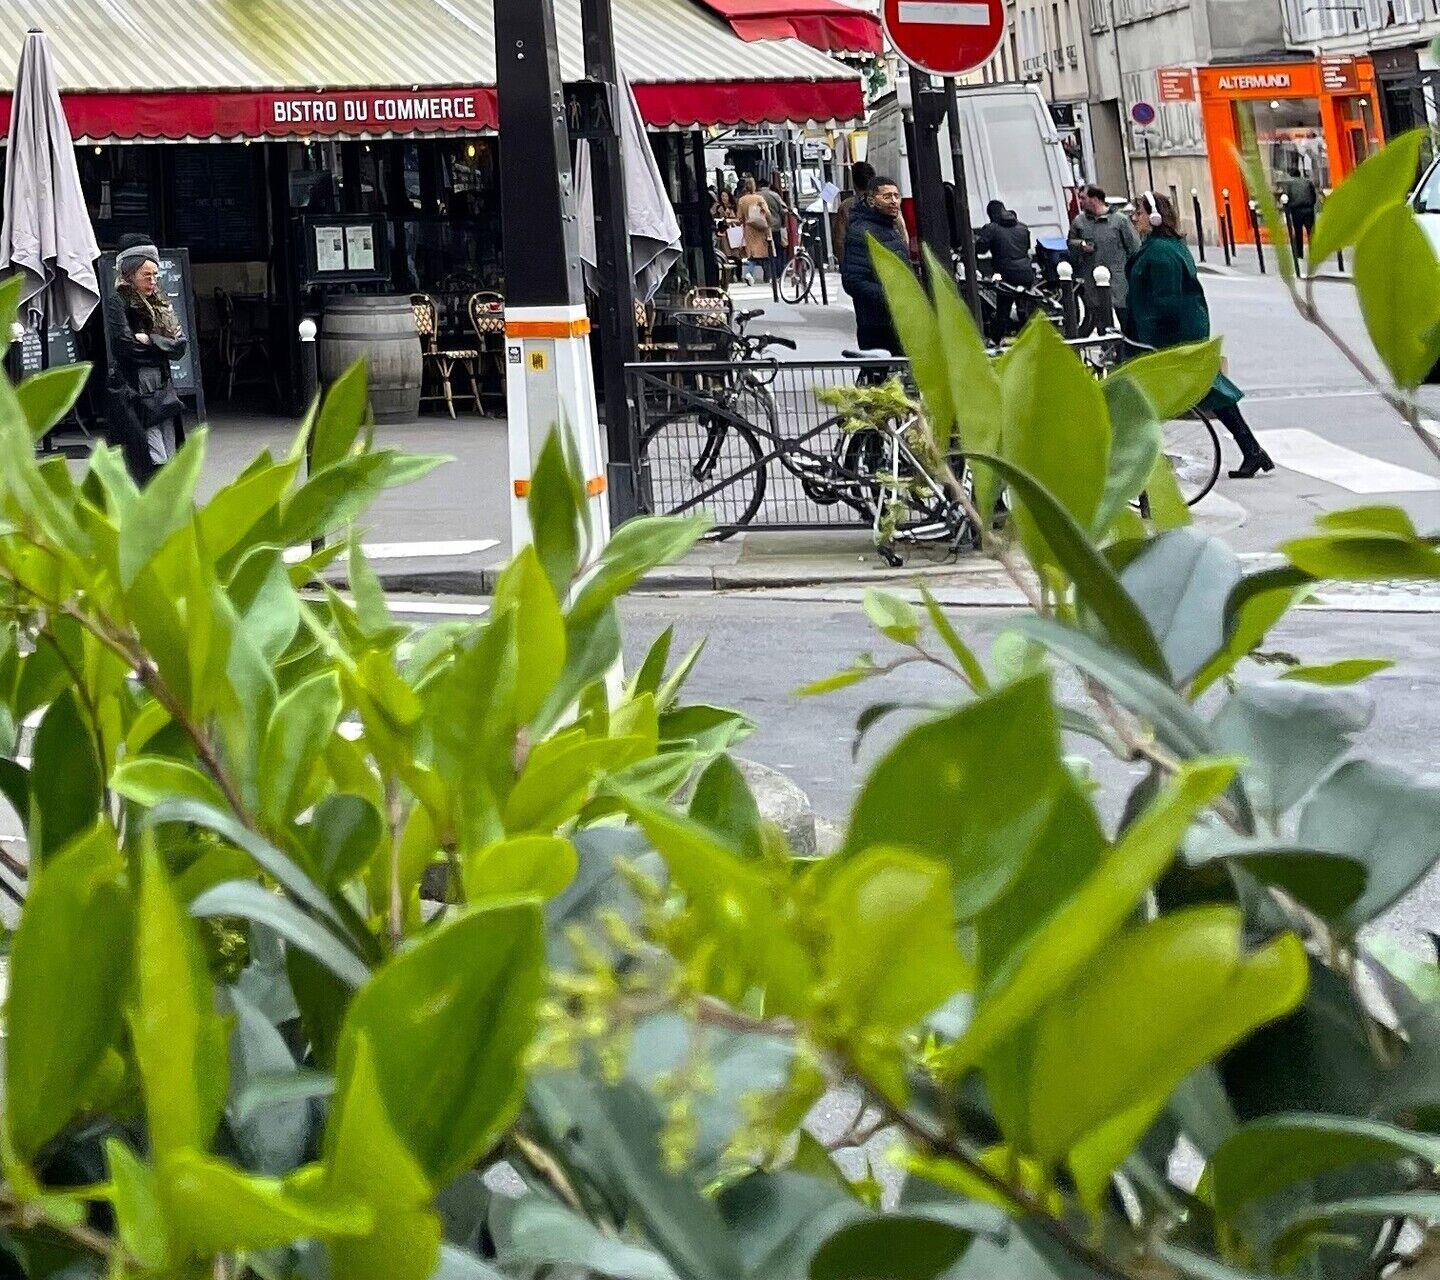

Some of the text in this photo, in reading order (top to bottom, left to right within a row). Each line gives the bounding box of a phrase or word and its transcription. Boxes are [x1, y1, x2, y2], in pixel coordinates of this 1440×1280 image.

[1218, 74, 1291, 90] ALTERMUNDI
[274, 97, 476, 122] BISTRO DU COMMERCE
